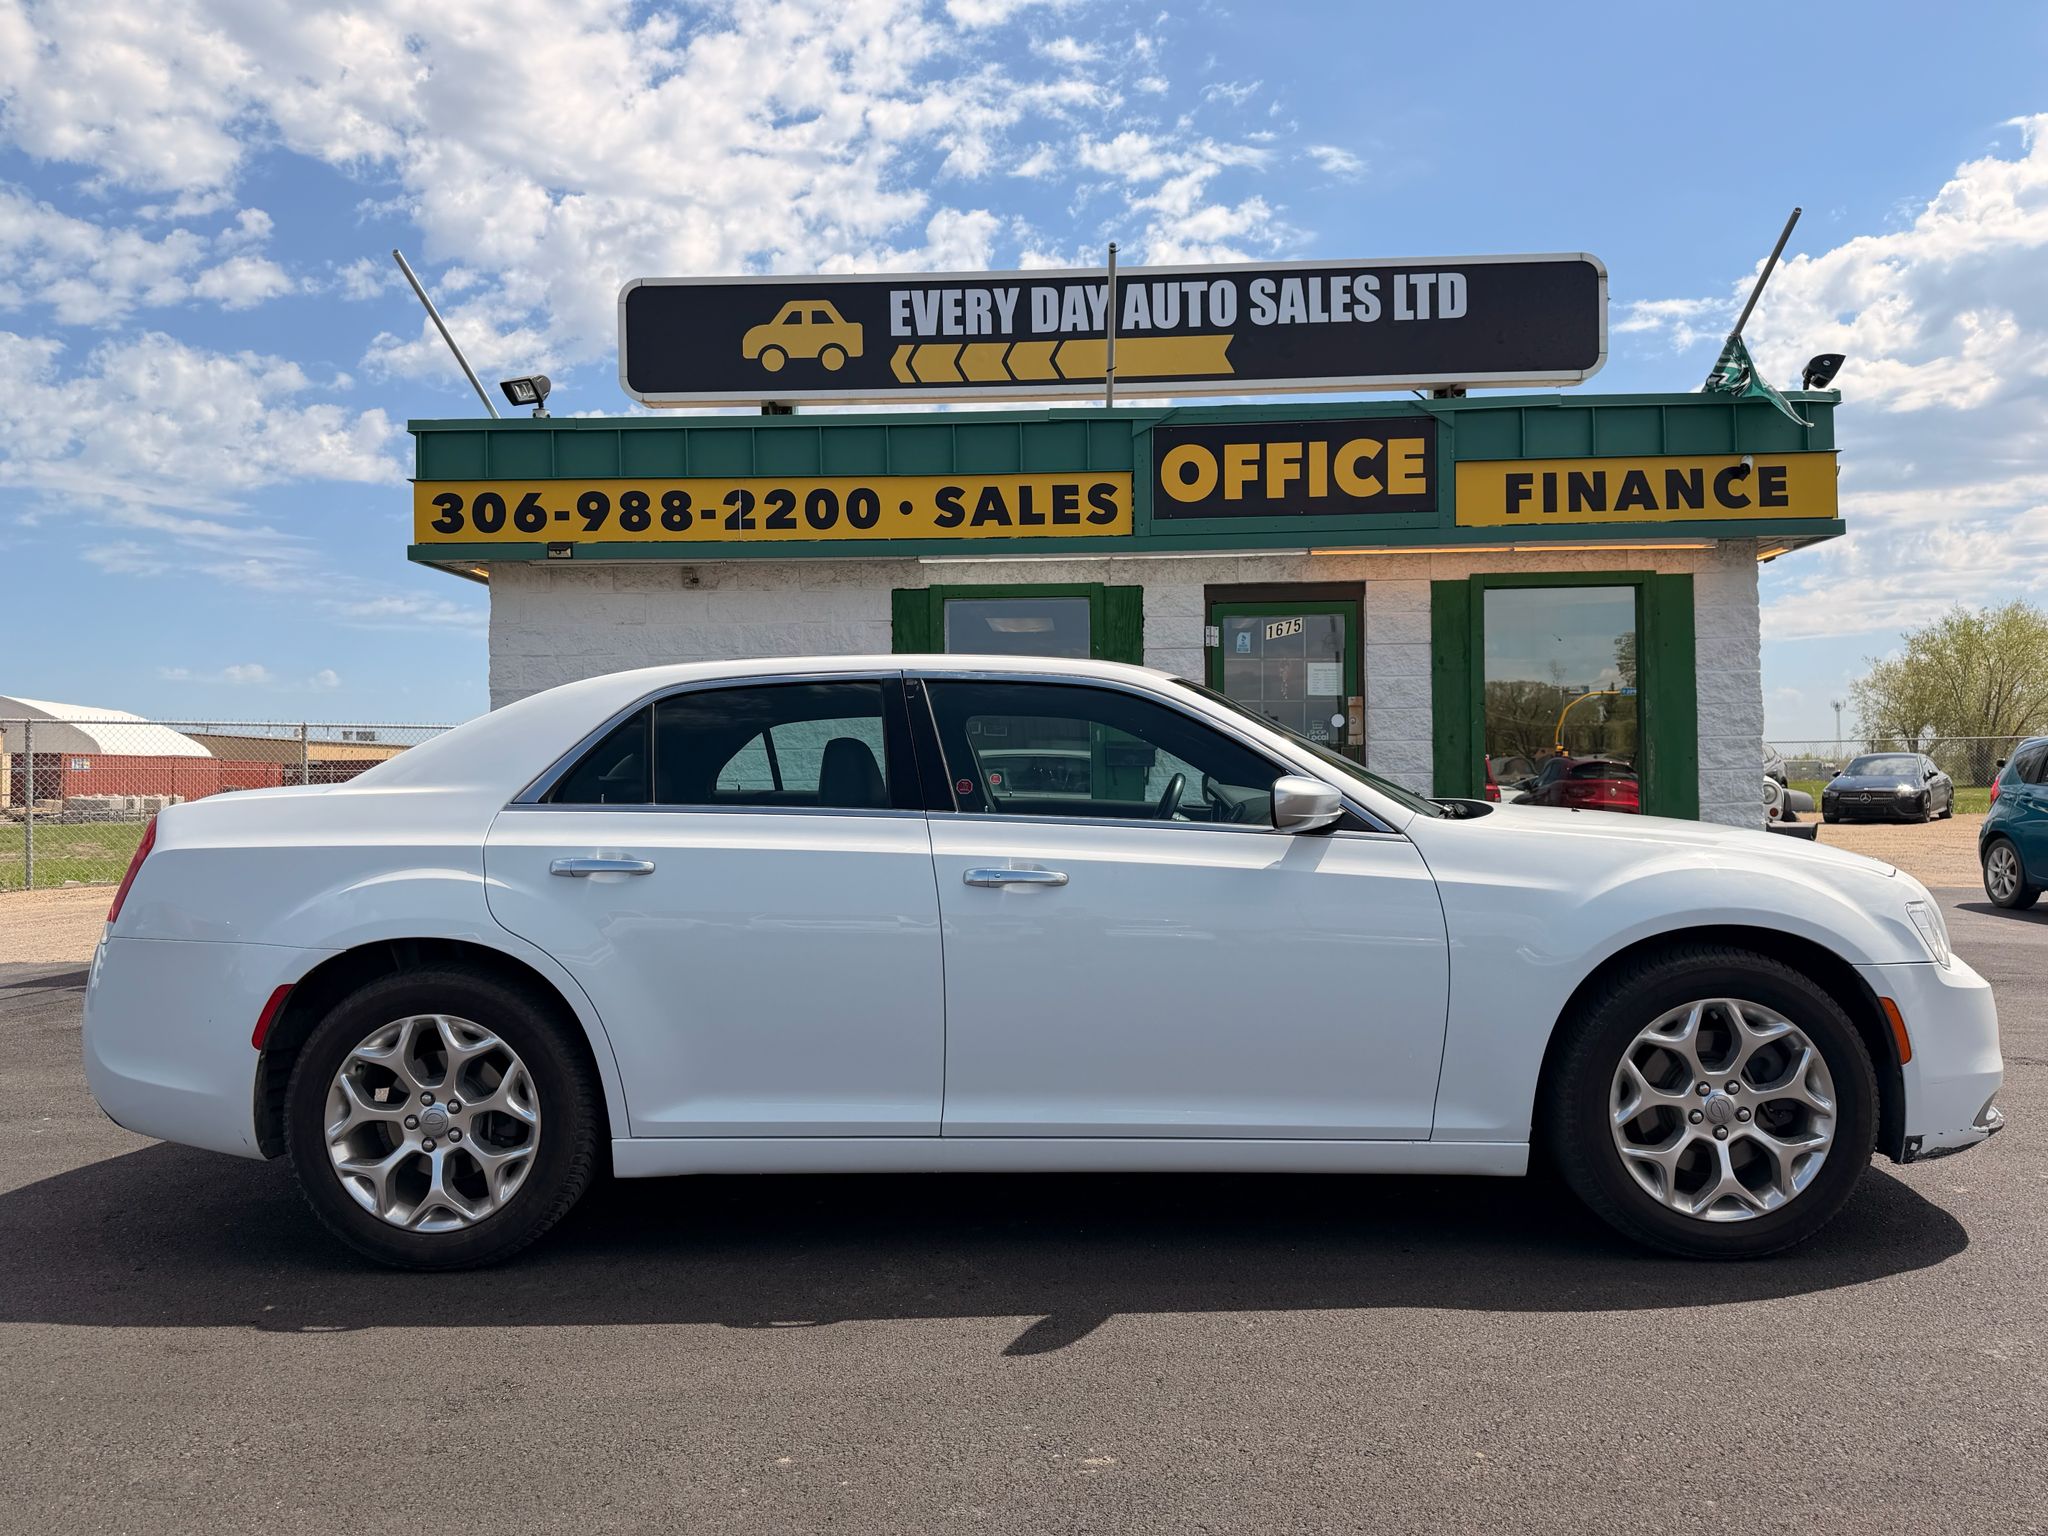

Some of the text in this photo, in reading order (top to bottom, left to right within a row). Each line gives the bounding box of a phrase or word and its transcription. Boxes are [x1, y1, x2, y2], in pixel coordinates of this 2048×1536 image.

[890, 272, 1468, 337] EVERY DAY AUTO SALES LTD
[1160, 437, 1427, 503] OFFICE
[1505, 466, 1789, 514] FINANCE
[430, 482, 1119, 534] 306-988-2200 SALES
[1268, 619, 1301, 639] 1675
